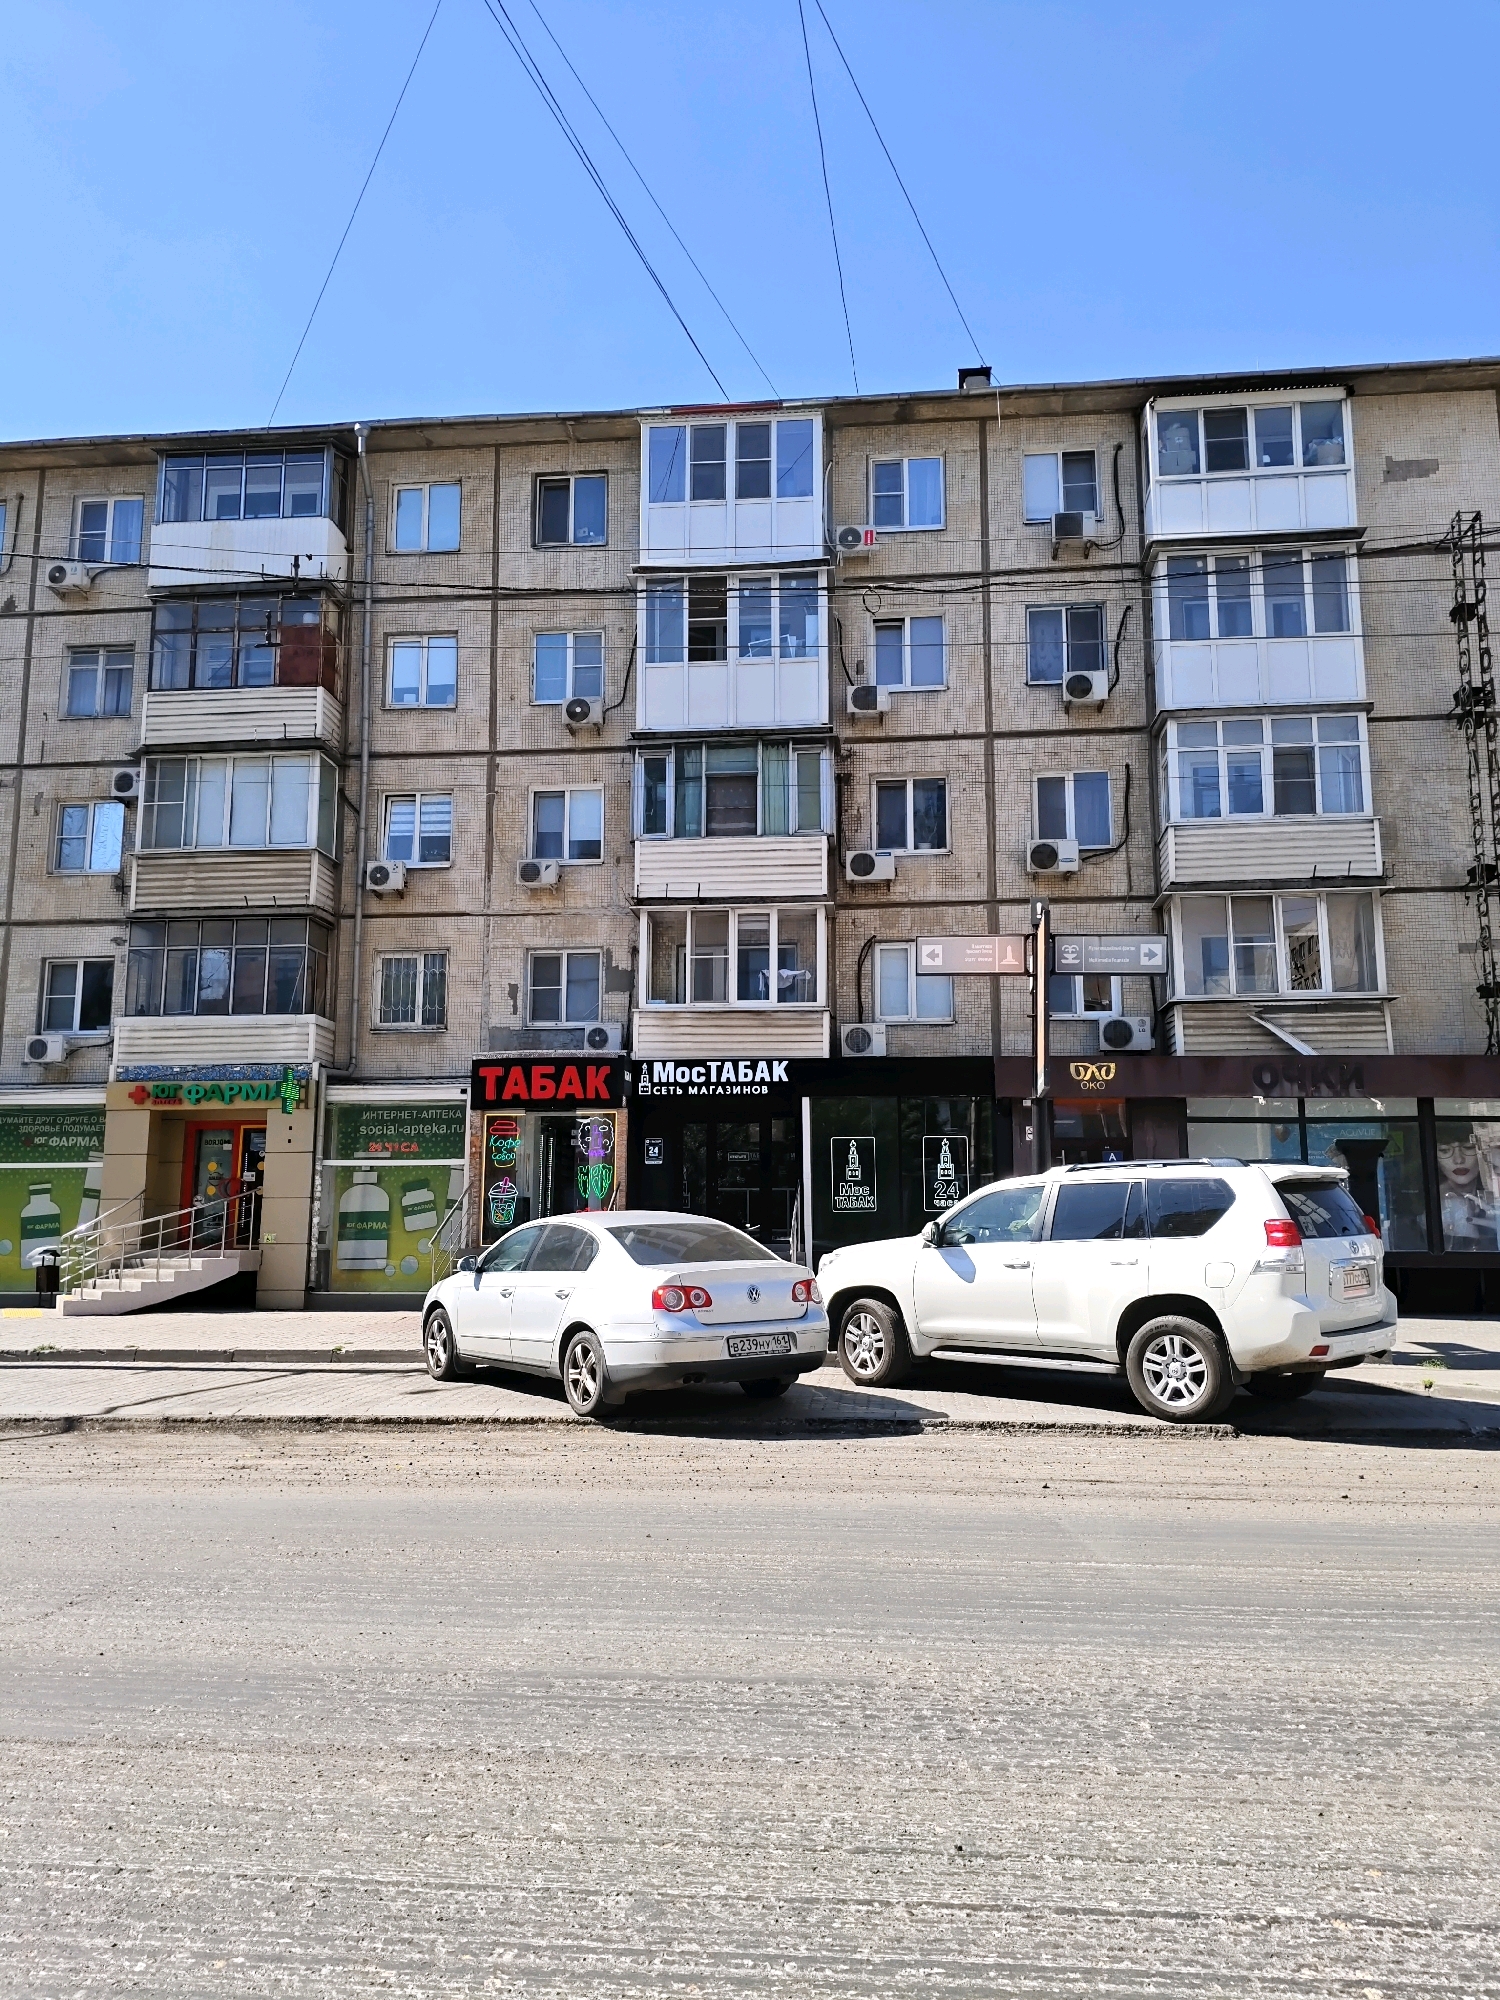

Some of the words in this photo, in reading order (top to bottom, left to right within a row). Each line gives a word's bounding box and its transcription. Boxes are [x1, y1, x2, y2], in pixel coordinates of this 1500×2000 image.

[653, 1061, 789, 1083] МосТАБАК
[479, 1066, 611, 1100] ТАБАК
[1080, 1081, 1106, 1090] ОКО
[152, 1084, 183, 1098] ЮГ
[653, 1086, 683, 1095] СЕТЬ
[688, 1085, 769, 1095] МАГАЗИНОВ
[35, 1116, 56, 1124] ДРУГ
[362, 1109, 462, 1120] ИНТЕРНЕТ-АПТЕКА
[18, 1125, 61, 1133] ЗДОРОВЬЕ
[360, 1123, 464, 1136] social-apteka.ru
[34, 1136, 48, 1144] ЮГ
[49, 1136, 100, 1147] ФАРМА
[489, 1135, 521, 1148] Кофе
[649, 1146, 659, 1154] 24
[840, 1182, 870, 1196] Мос
[933, 1180, 960, 1198] 24
[834, 1196, 875, 1208] ТАБАК
[35, 1222, 60, 1230] ФАРМА
[356, 1221, 388, 1230] ФАРМА
